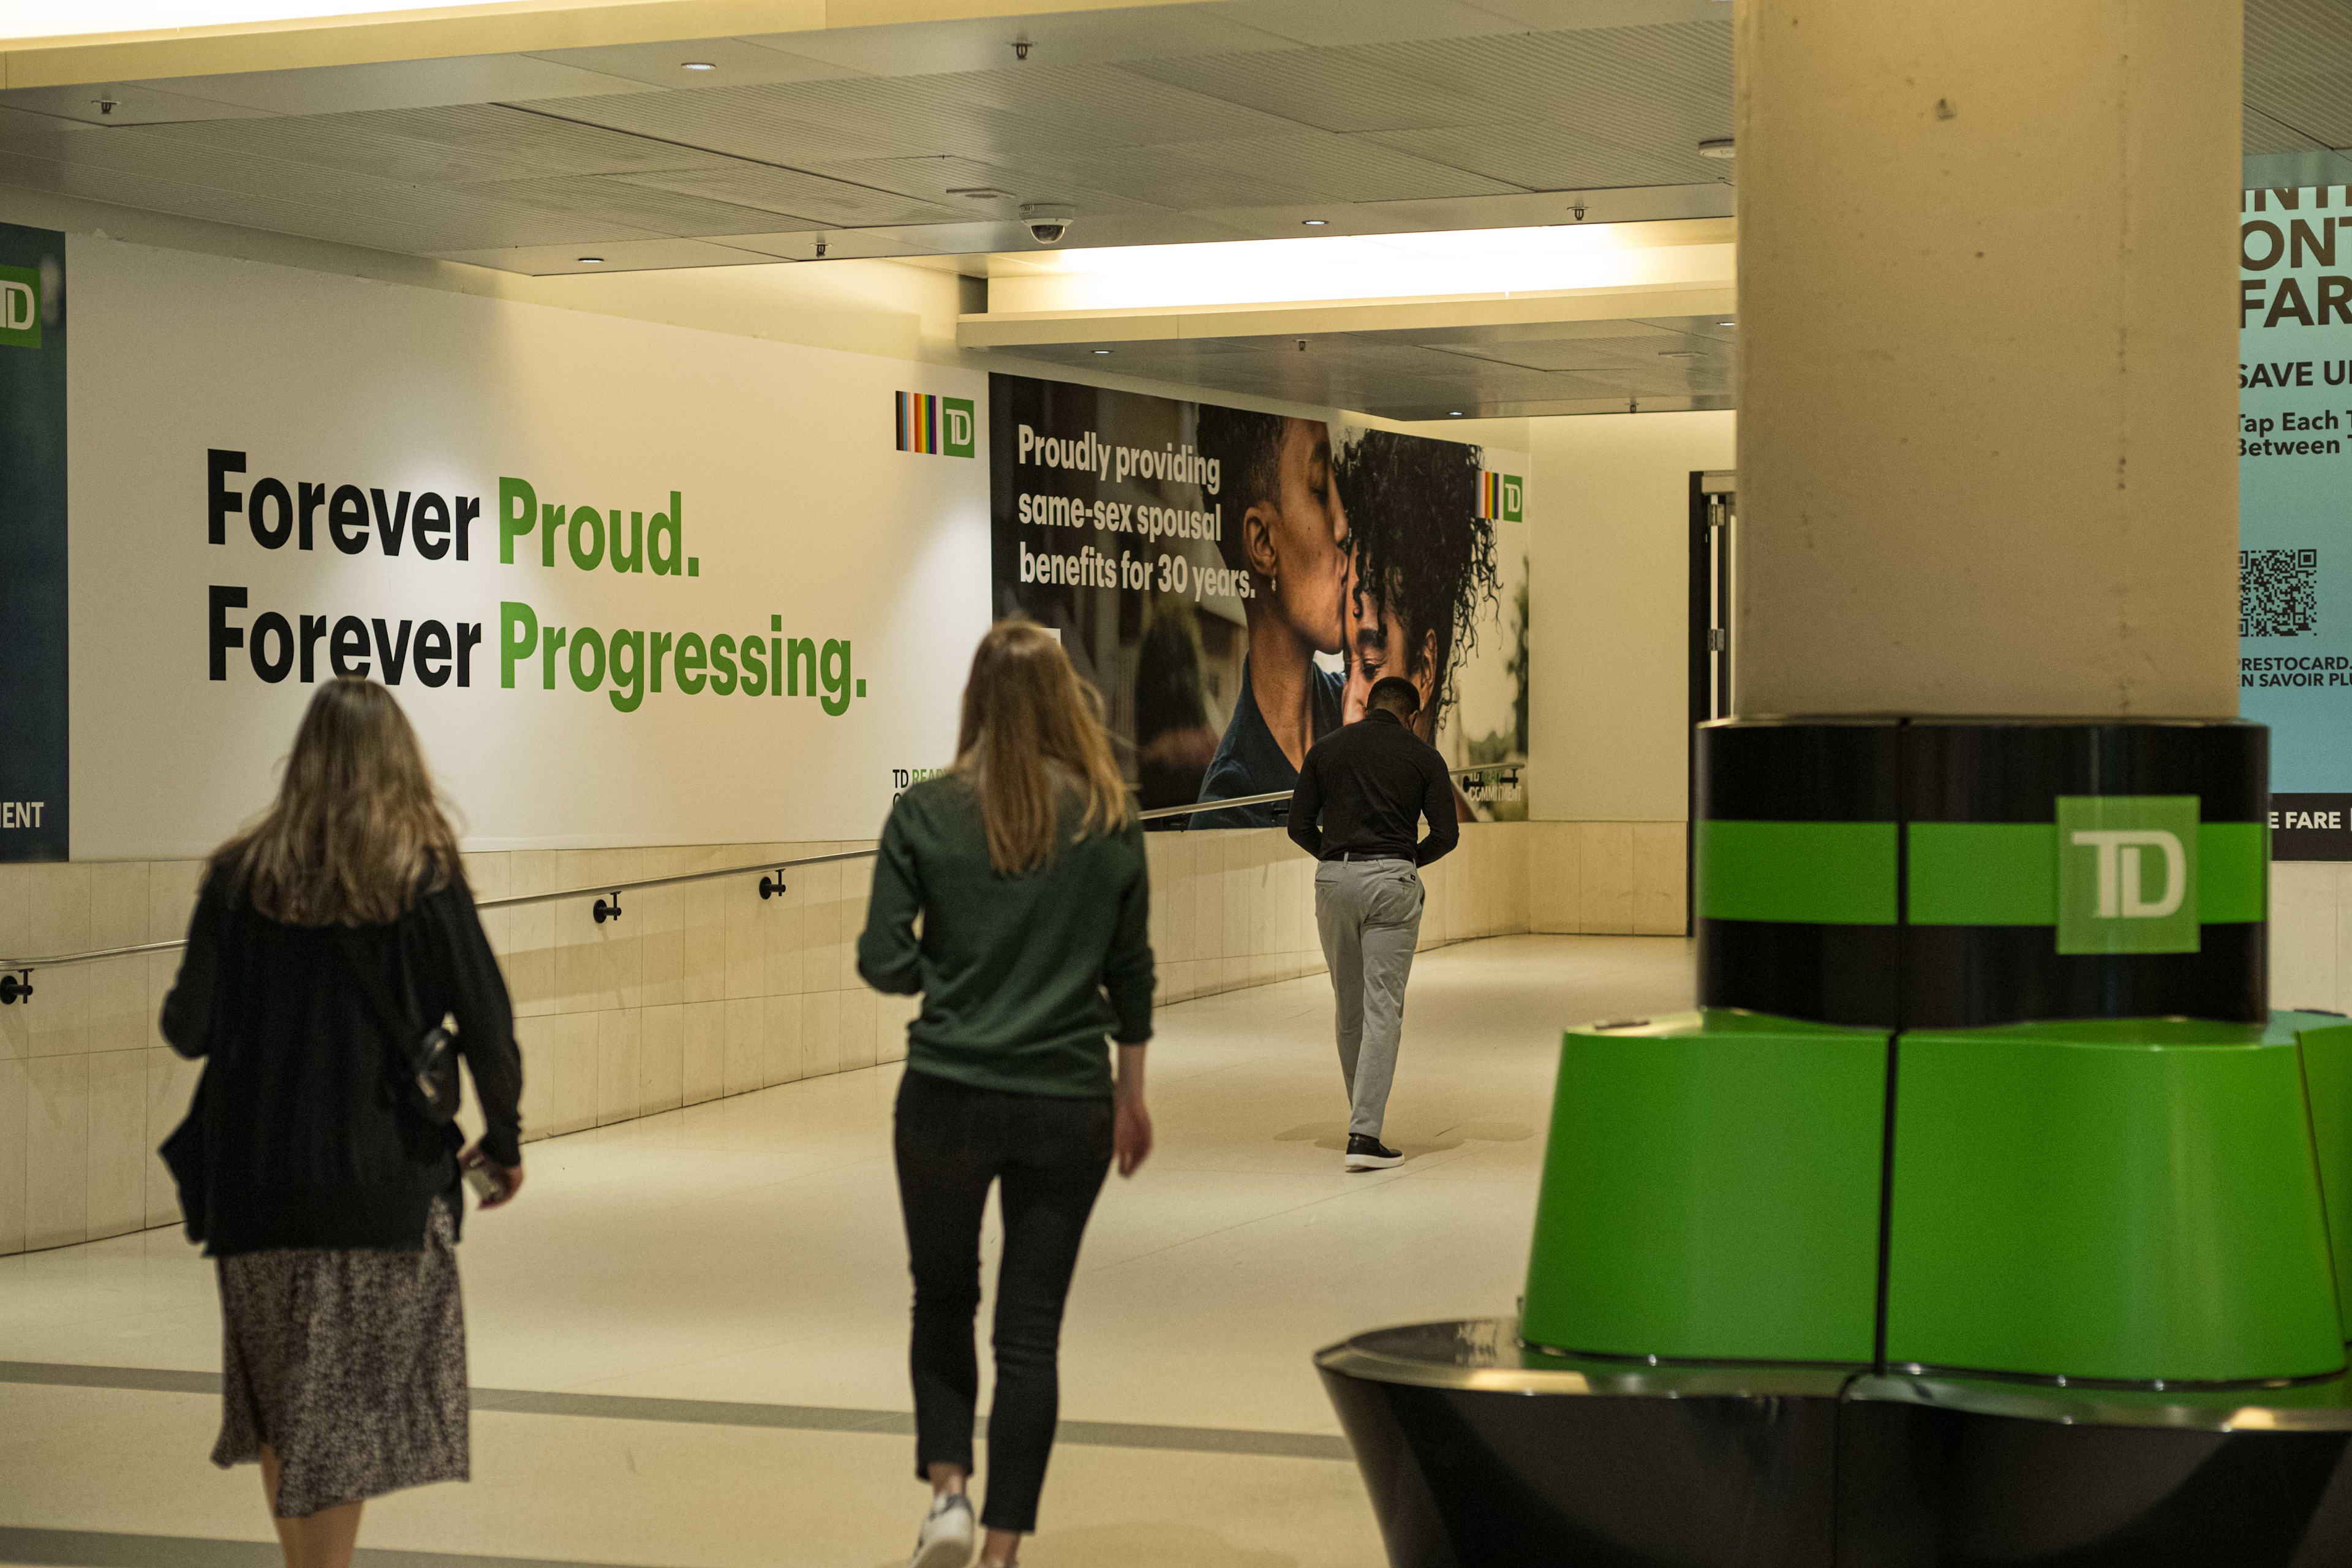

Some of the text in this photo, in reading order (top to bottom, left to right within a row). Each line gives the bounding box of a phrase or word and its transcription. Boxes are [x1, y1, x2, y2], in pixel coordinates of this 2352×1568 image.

[2239, 361, 2313, 389] SAVE
[946, 409, 971, 446] TD
[2283, 410, 2339, 431] Each
[1019, 424, 1221, 495] Proudly providing
[208, 448, 699, 577] Forever Proud.
[1505, 483, 1521, 513] TD
[1019, 493, 1221, 543] same-sex spousal
[1020, 541, 1256, 602] benefits for 30 years.
[209, 585, 867, 717] Forever Progressing.
[2237, 674, 2254, 687] N
[2259, 673, 2324, 687] SAVOIR
[892, 769, 909, 788] TD
[0, 802, 45, 828] ENT
[2285, 812, 2342, 829] FARE
[2072, 830, 2187, 918] TD
